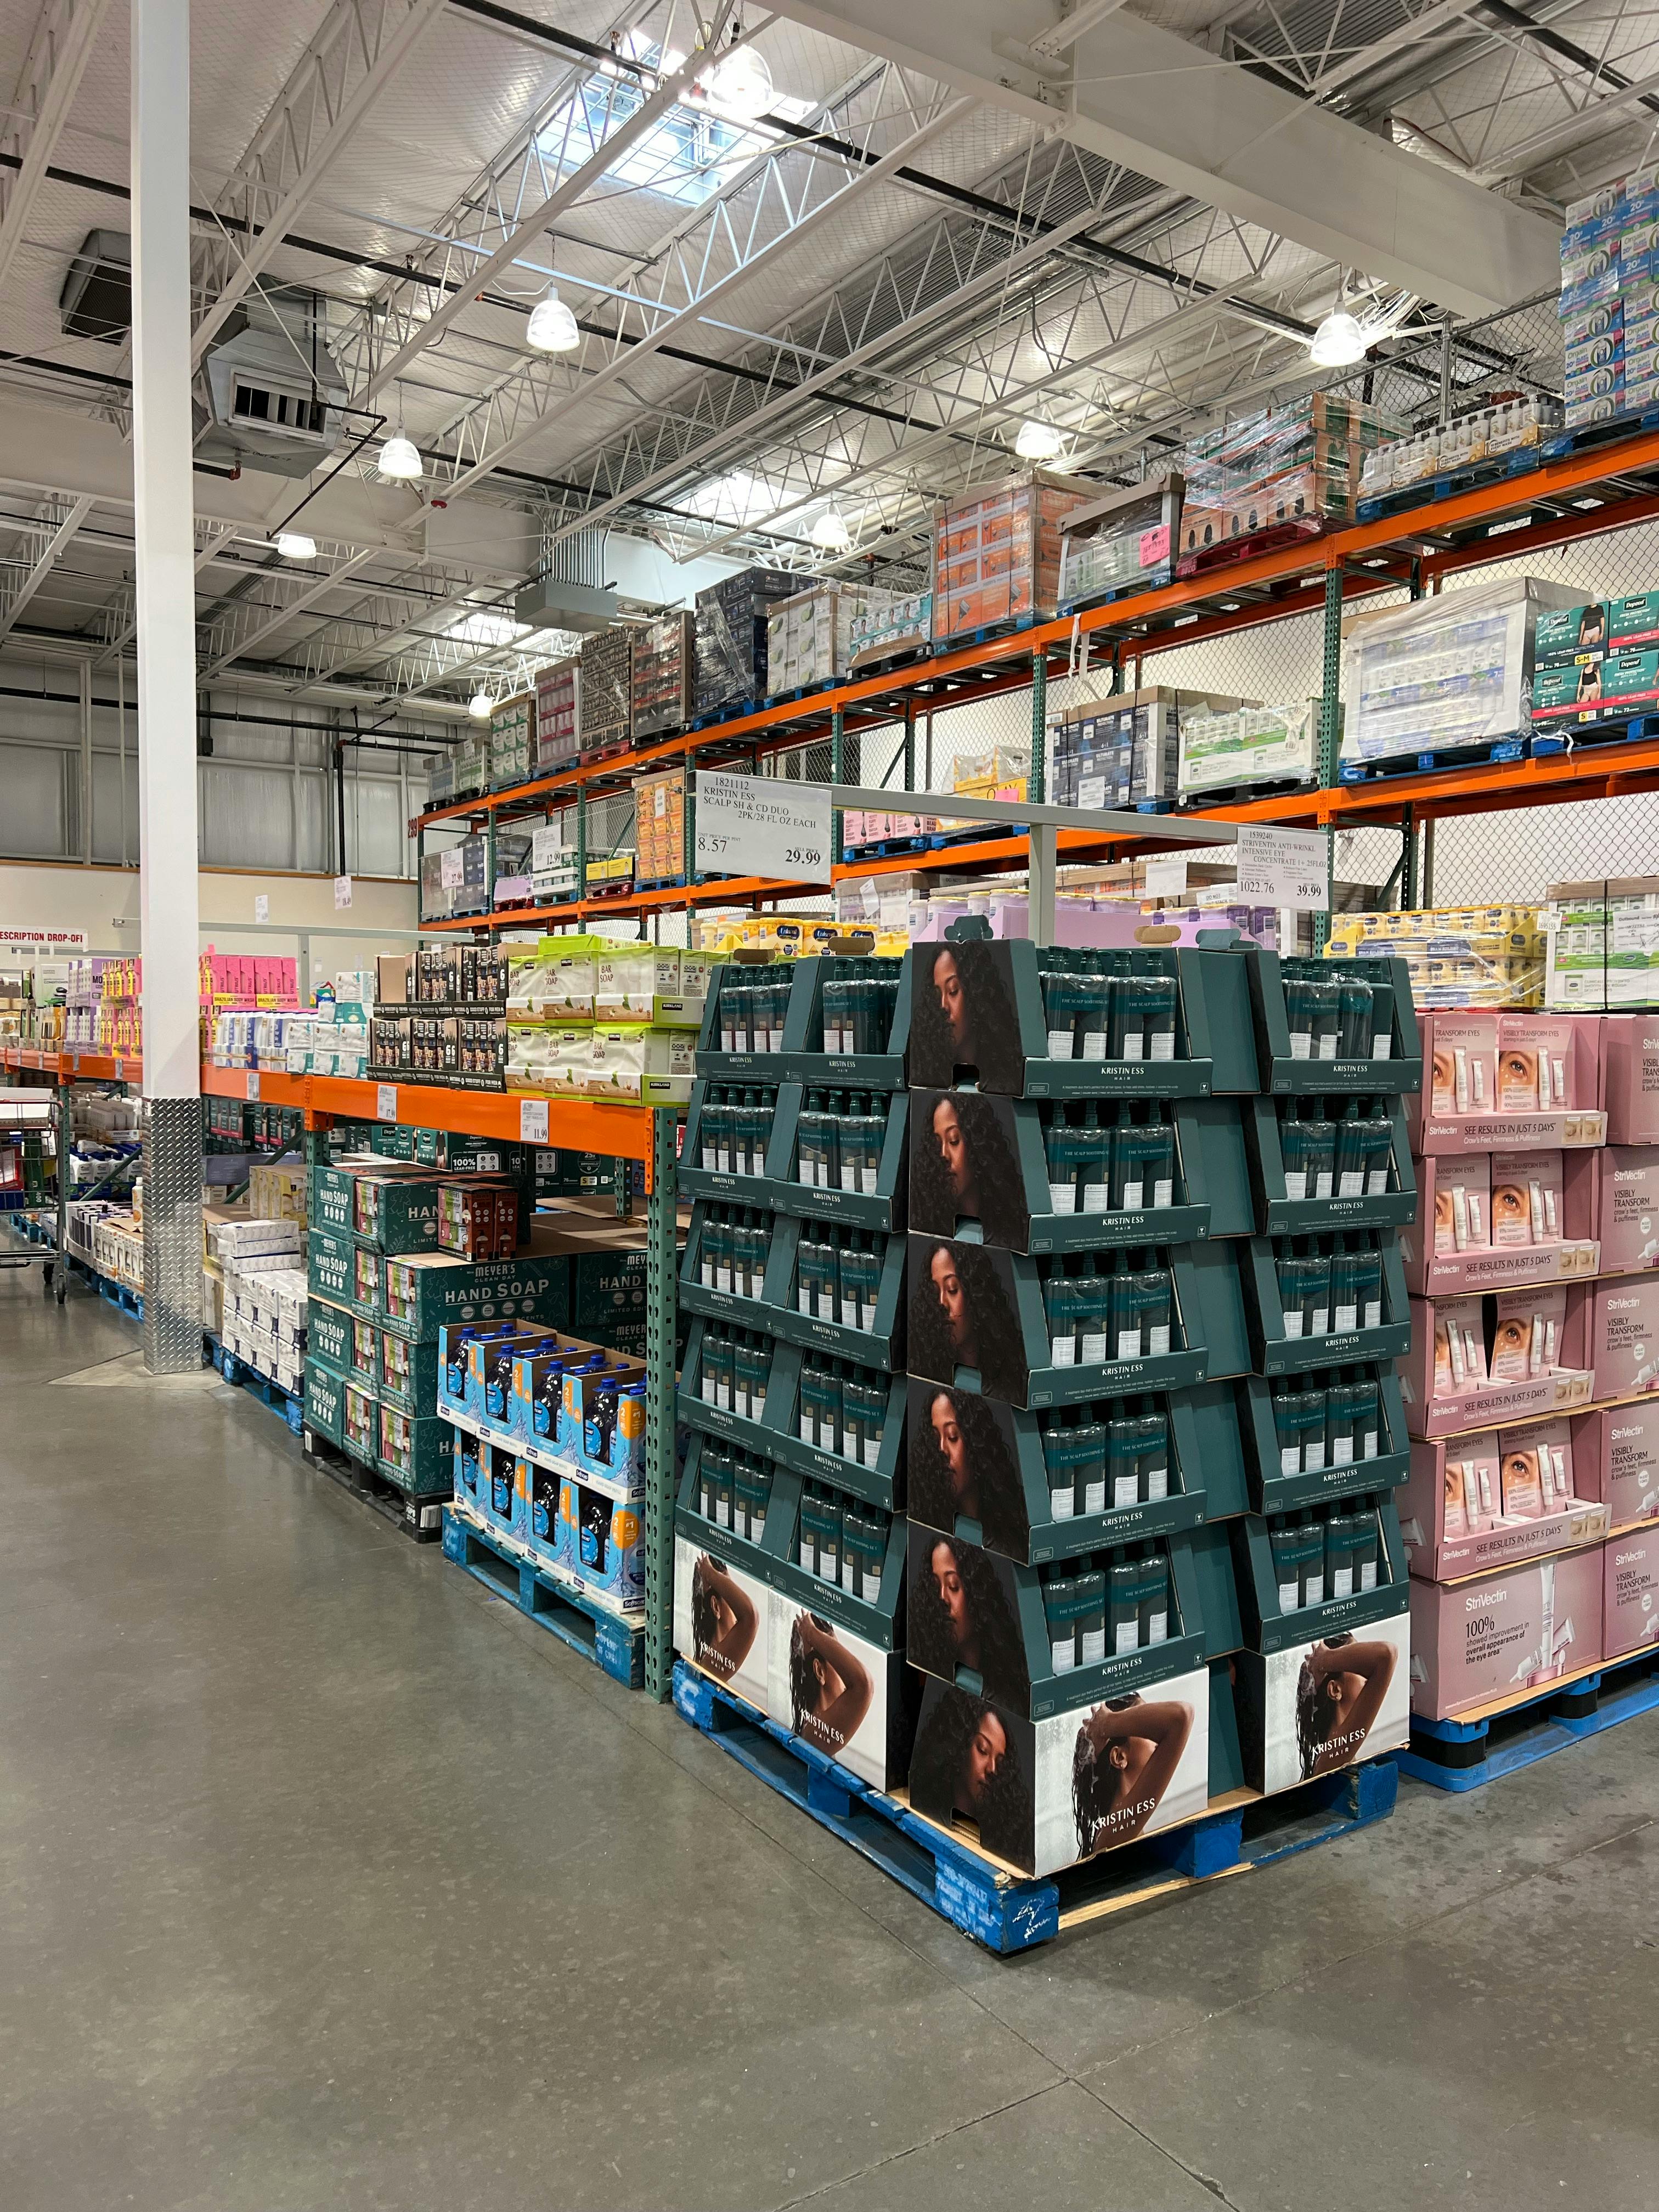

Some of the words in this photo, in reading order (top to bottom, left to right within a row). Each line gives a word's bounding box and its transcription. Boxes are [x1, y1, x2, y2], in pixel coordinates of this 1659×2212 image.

[1627, 323, 1649, 336] Orgain
[1567, 348, 1587, 359] Orgain
[1626, 599, 1645, 608] Depend
[1621, 659, 1640, 667] Depend
[715, 777, 749, 790] 1821112
[704, 786, 738, 798] KRISTIN
[741, 792, 755, 801] ESS
[704, 796, 731, 806] SCALP
[733, 801, 744, 809] SH
[756, 804, 768, 812] CD
[771, 806, 789, 815] DUO
[738, 810, 765, 821] 2PK/28
[767, 815, 777, 823] FL
[780, 816, 791, 825] OZ
[793, 819, 816, 828] EACH
[1250, 832, 1273, 840] 1539240
[698, 837, 727, 853] 8.57
[1242, 840, 1276, 848] STRIVENTIN
[786, 849, 820, 865] 29.99
[1242, 848, 1273, 856] INTENSIVE
[547, 853, 560, 865] 12.99
[1254, 856, 1296, 865] CONCENTRATE
[1240, 881, 1274, 894] 1022.76
[1297, 885, 1321, 896] 39.99
[601, 965, 612, 973] BAR
[600, 974, 613, 983] SOAP
[534, 1128, 548, 1139] 11.99
[1429, 1126, 1458, 1135] StriVectin
[1464, 1126, 1476, 1135] SEE
[1478, 1125, 1506, 1133] RESULTS
[1508, 1124, 1515, 1133] IN
[1516, 1124, 1532, 1133] JUST
[1532, 1123, 1537, 1132] 5
[1614, 1170, 1646, 1181] StriVectin
[320, 1189, 332, 1202] HAND
[334, 1190, 348, 1206] SOAP
[1614, 1189, 1635, 1198] VISIBLY
[1614, 1198, 1650, 1207] TRANSFORM
[475, 1264, 515, 1277] MEYER'S
[1433, 1266, 1460, 1275] StriVectin
[1466, 1263, 1477, 1273] SEE
[1479, 1260, 1505, 1271] RESULTS
[1507, 1259, 1514, 1268] IN
[1514, 1258, 1529, 1268] JUST
[1530, 1257, 1534, 1265] 5
[600, 1276, 641, 1289] HAND
[445, 1288, 492, 1303] HAND
[497, 1279, 549, 1297] SOAP
[1607, 1297, 1640, 1310] StriVectin
[1607, 1317, 1629, 1326] VISIBLY
[1607, 1324, 1644, 1336] TRANSFORM
[1102, 1366, 1129, 1375] KRISTIN
[1432, 1406, 1458, 1417] StriVectin
[1102, 1515, 1129, 1527] KRISTIN
[1131, 1512, 1143, 1520] ESS
[1443, 1549, 1469, 1560] StriVectin
[1466, 1589, 1508, 1611] StriVectin
[1466, 1615, 1494, 1638] 100%
[1466, 1633, 1487, 1647] showed
[1488, 1623, 1523, 1640] improvement
[1466, 1643, 1486, 1656] overall
[1487, 1634, 1518, 1650] appearance
[1520, 1629, 1525, 1639] of
[700, 1641, 724, 1664] KRISTIN
[725, 1657, 735, 1671] ESS
[1466, 1656, 1475, 1664] the
[1476, 1653, 1486, 1662] eye
[712, 1661, 724, 1671] HAIR
[1102, 1661, 1128, 1675] KRISTIN
[1130, 1658, 1142, 1667] ESS
[800, 1708, 829, 1735] KRISTIN
[831, 1728, 844, 1745] ESS
[814, 1730, 830, 1744] HAIR
[1312, 1735, 1347, 1756] KRISTIN
[1350, 1729, 1365, 1742] ESS
[1329, 1747, 1349, 1758] HAIR
[1092, 1807, 1133, 1831] KRISTIN
[1137, 1798, 1155, 1813] ESS
[1113, 1820, 1136, 1833] HAIR
